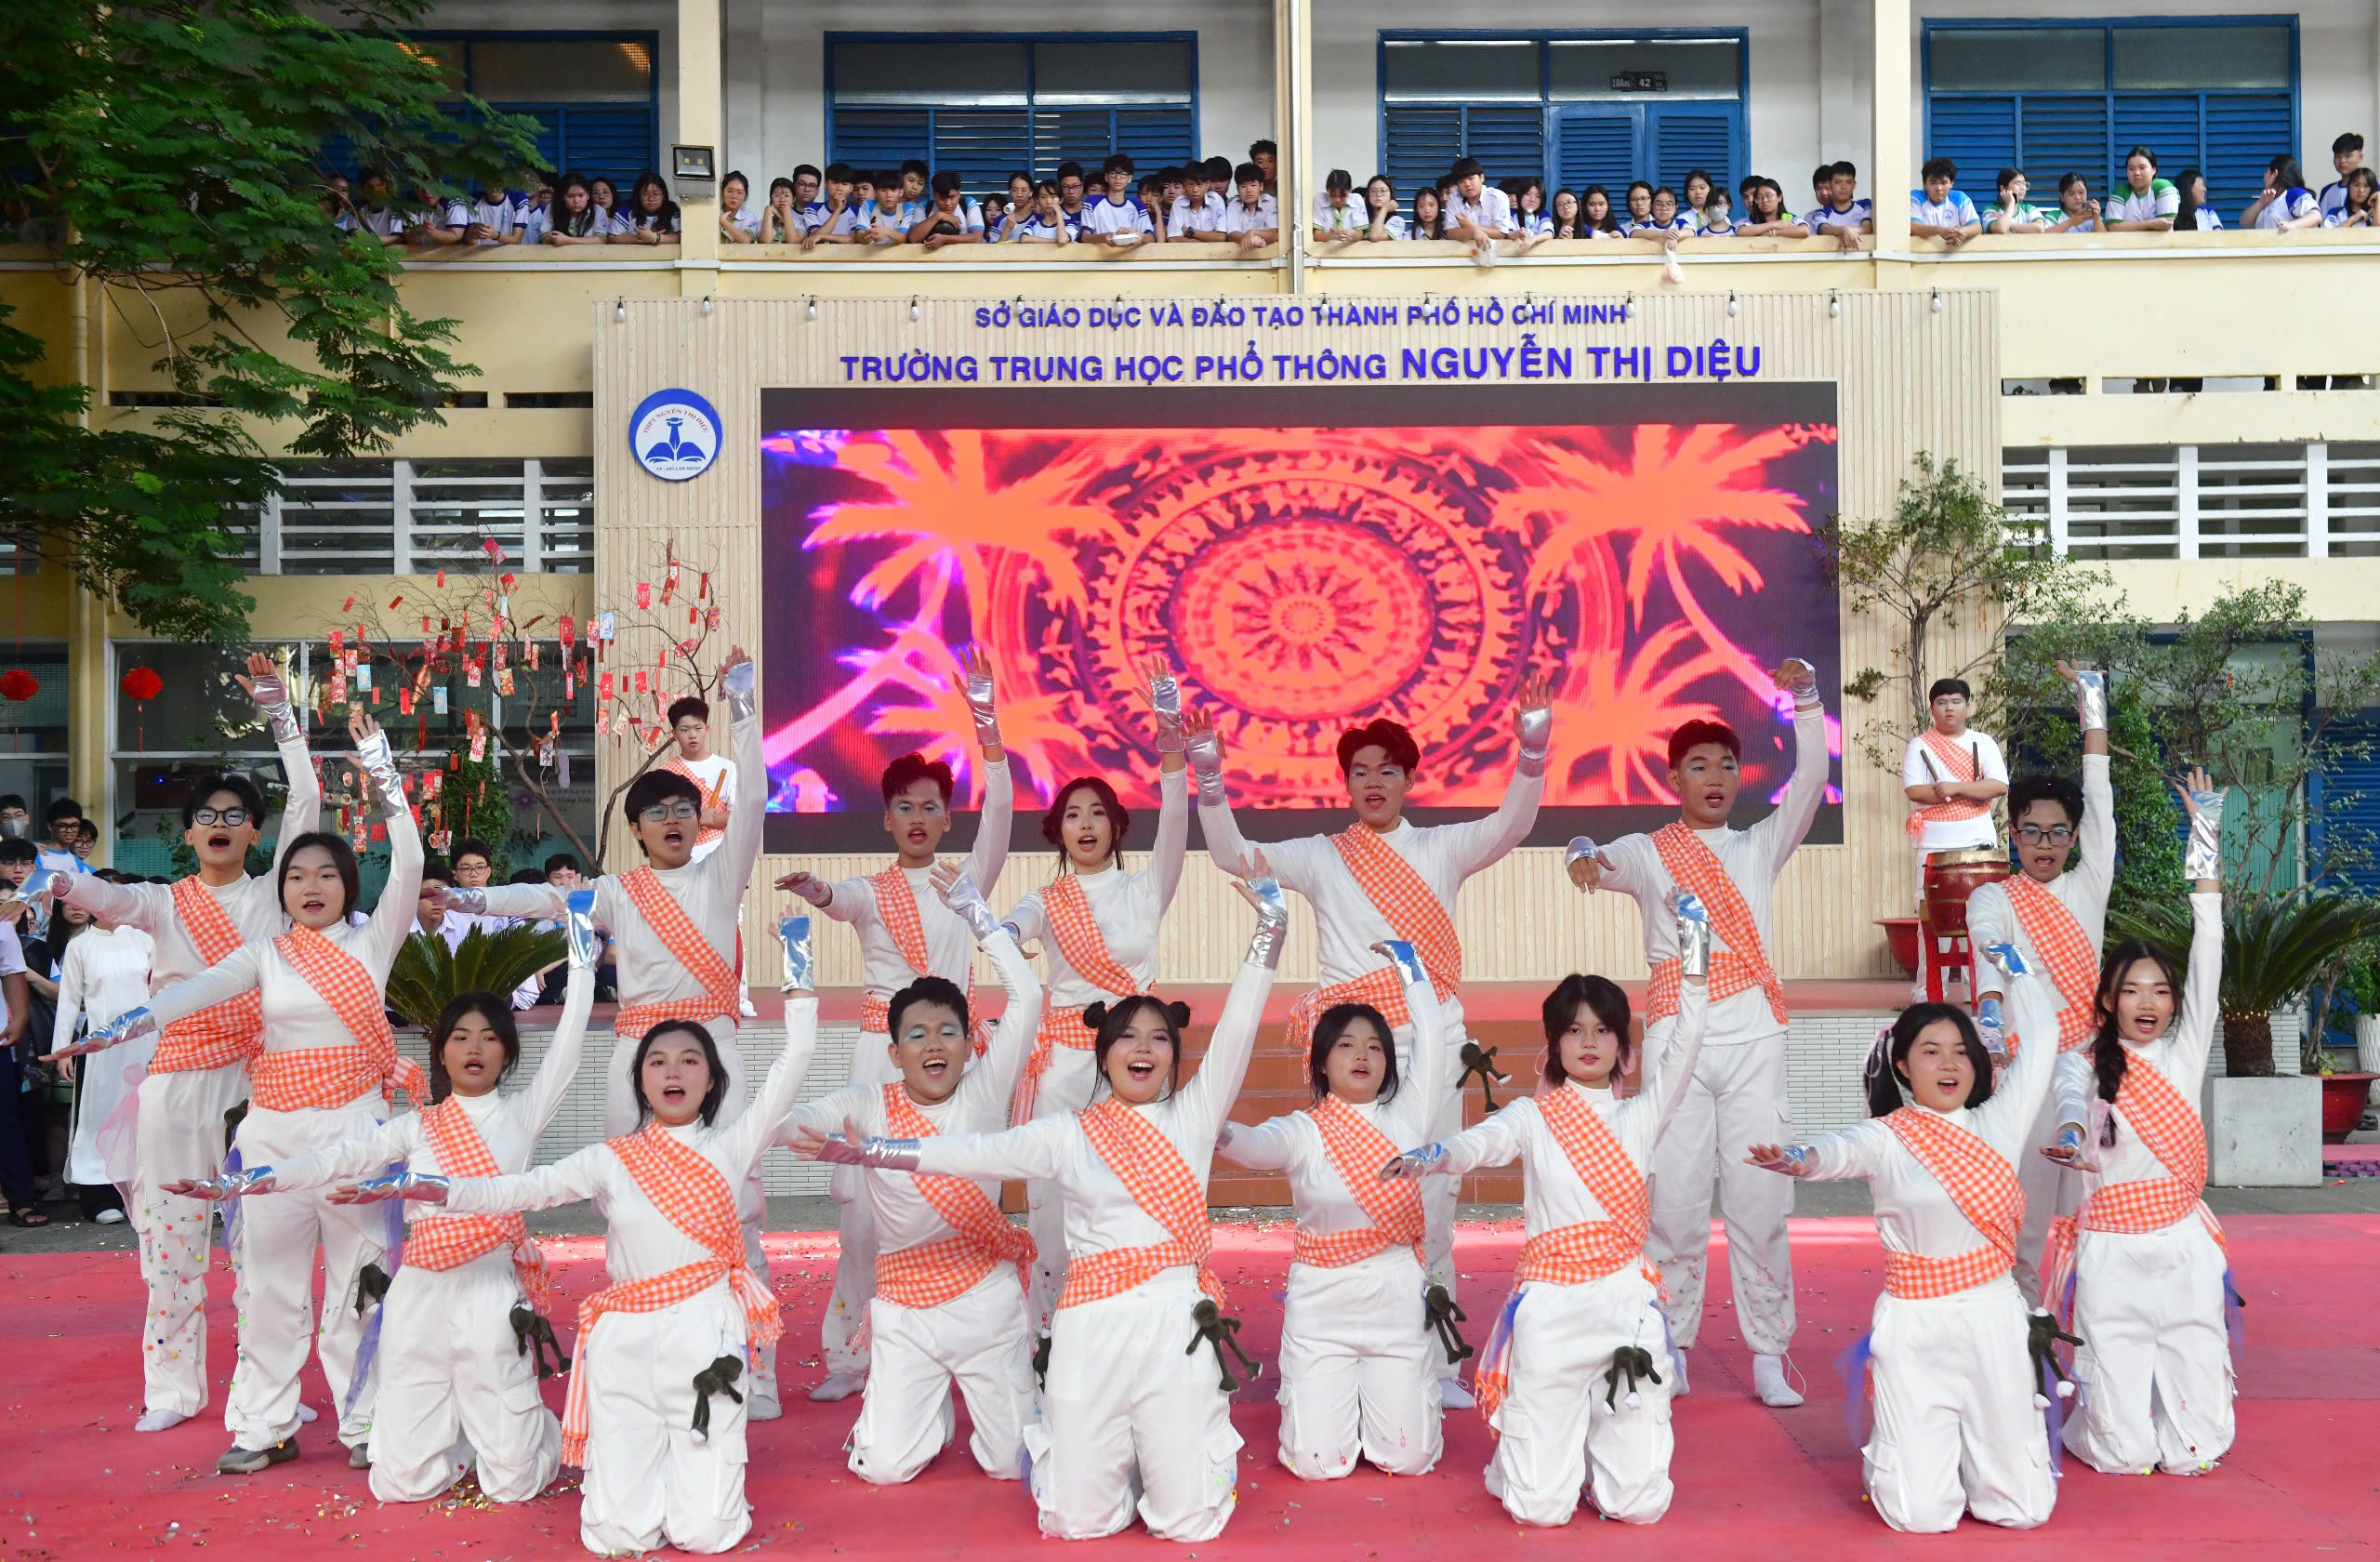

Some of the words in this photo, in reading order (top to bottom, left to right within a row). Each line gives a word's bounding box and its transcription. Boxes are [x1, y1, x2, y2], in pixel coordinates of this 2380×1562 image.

[1638, 78, 1651, 87] 42
[975, 299, 1012, 327] SỞ
[1018, 302, 1081, 327] GIÁO
[1089, 307, 1142, 331] DỤC
[1150, 302, 1183, 326] VÀ
[1192, 301, 1246, 326] ĐÀO
[1253, 306, 1304, 330] TẠO
[1311, 301, 1398, 326] THÀNH
[1407, 296, 1461, 325] PHỐ
[1468, 296, 1504, 325] HỒ
[1512, 299, 1556, 324] CHÍ
[1563, 304, 1627, 324] MINH
[840, 348, 978, 381] TRƯỜNG
[988, 355, 1104, 381] TRUNG
[1115, 354, 1183, 386] HỌC
[1196, 339, 1264, 380] PHỔ
[1272, 348, 1387, 379] THÔNG
[1401, 333, 1573, 379] NGUYỄN
[1586, 346, 1652, 382] THỊ
[1667, 338, 1761, 382] DIỆU
